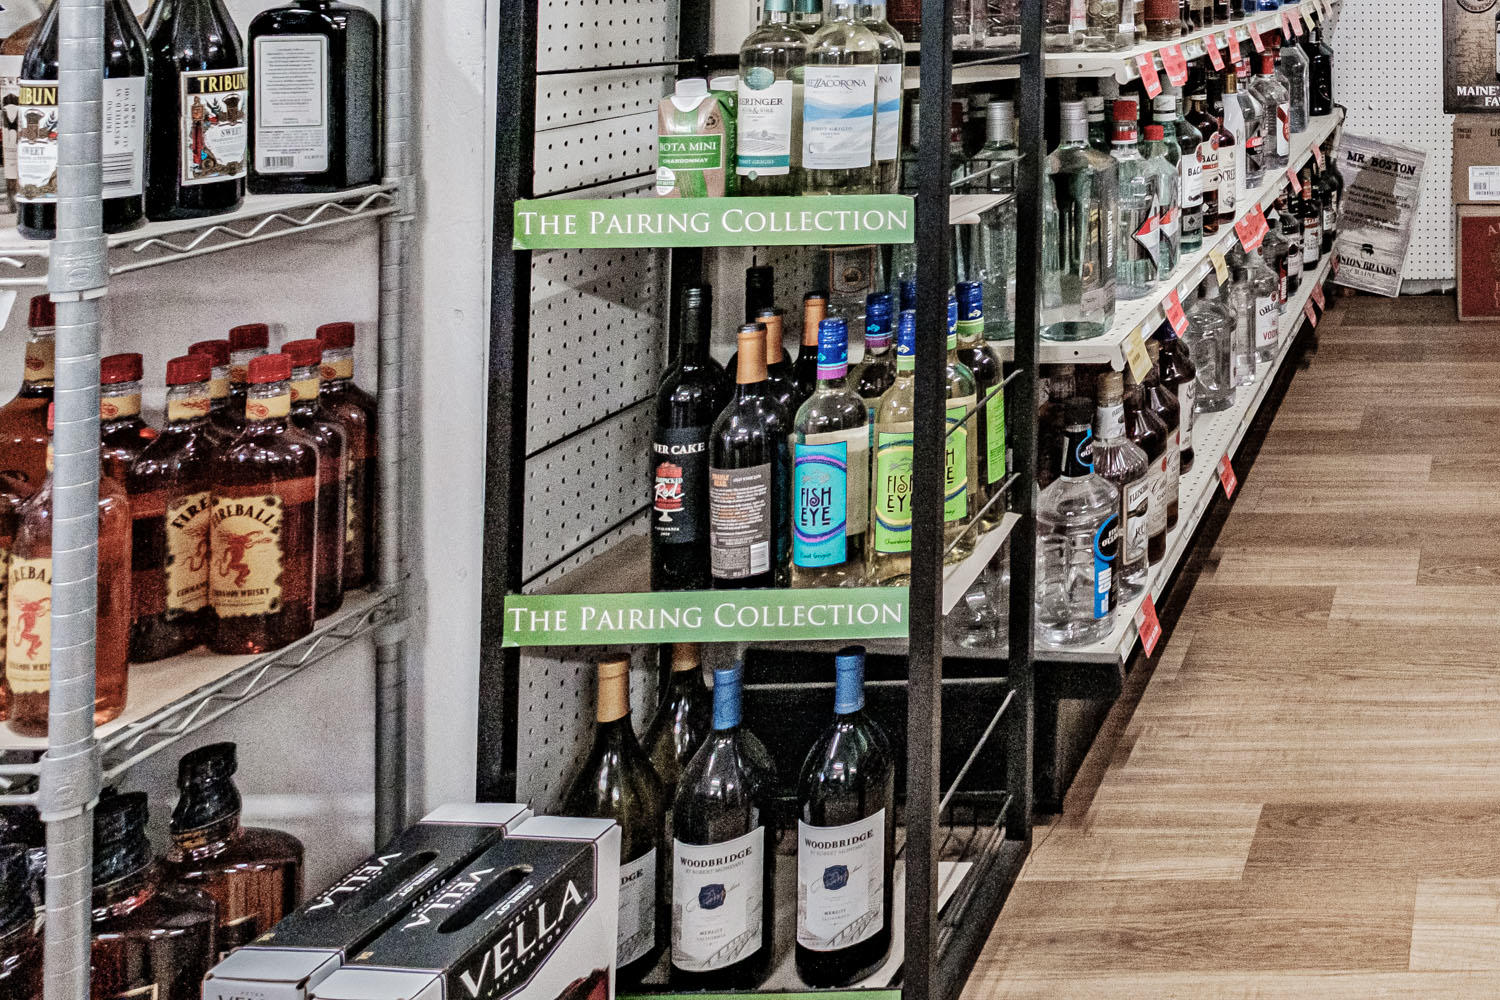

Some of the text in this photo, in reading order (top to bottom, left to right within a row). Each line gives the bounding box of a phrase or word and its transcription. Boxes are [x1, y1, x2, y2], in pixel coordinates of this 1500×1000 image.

[689, 141, 717, 151] MINI
[1371, 156, 1416, 176] BOSTON
[518, 208, 908, 235] THE PAIRING COLLECTION
[671, 442, 705, 455] CAKE
[801, 487, 832, 507] FISH
[888, 494, 913, 512] EY
[801, 507, 832, 526] EYE
[508, 601, 902, 632] THE PAIRING COLLECTION
[804, 829, 874, 849] WOODBRIDGE
[680, 846, 753, 868] WOODBRIDGE
[459, 879, 583, 998] VELLA
